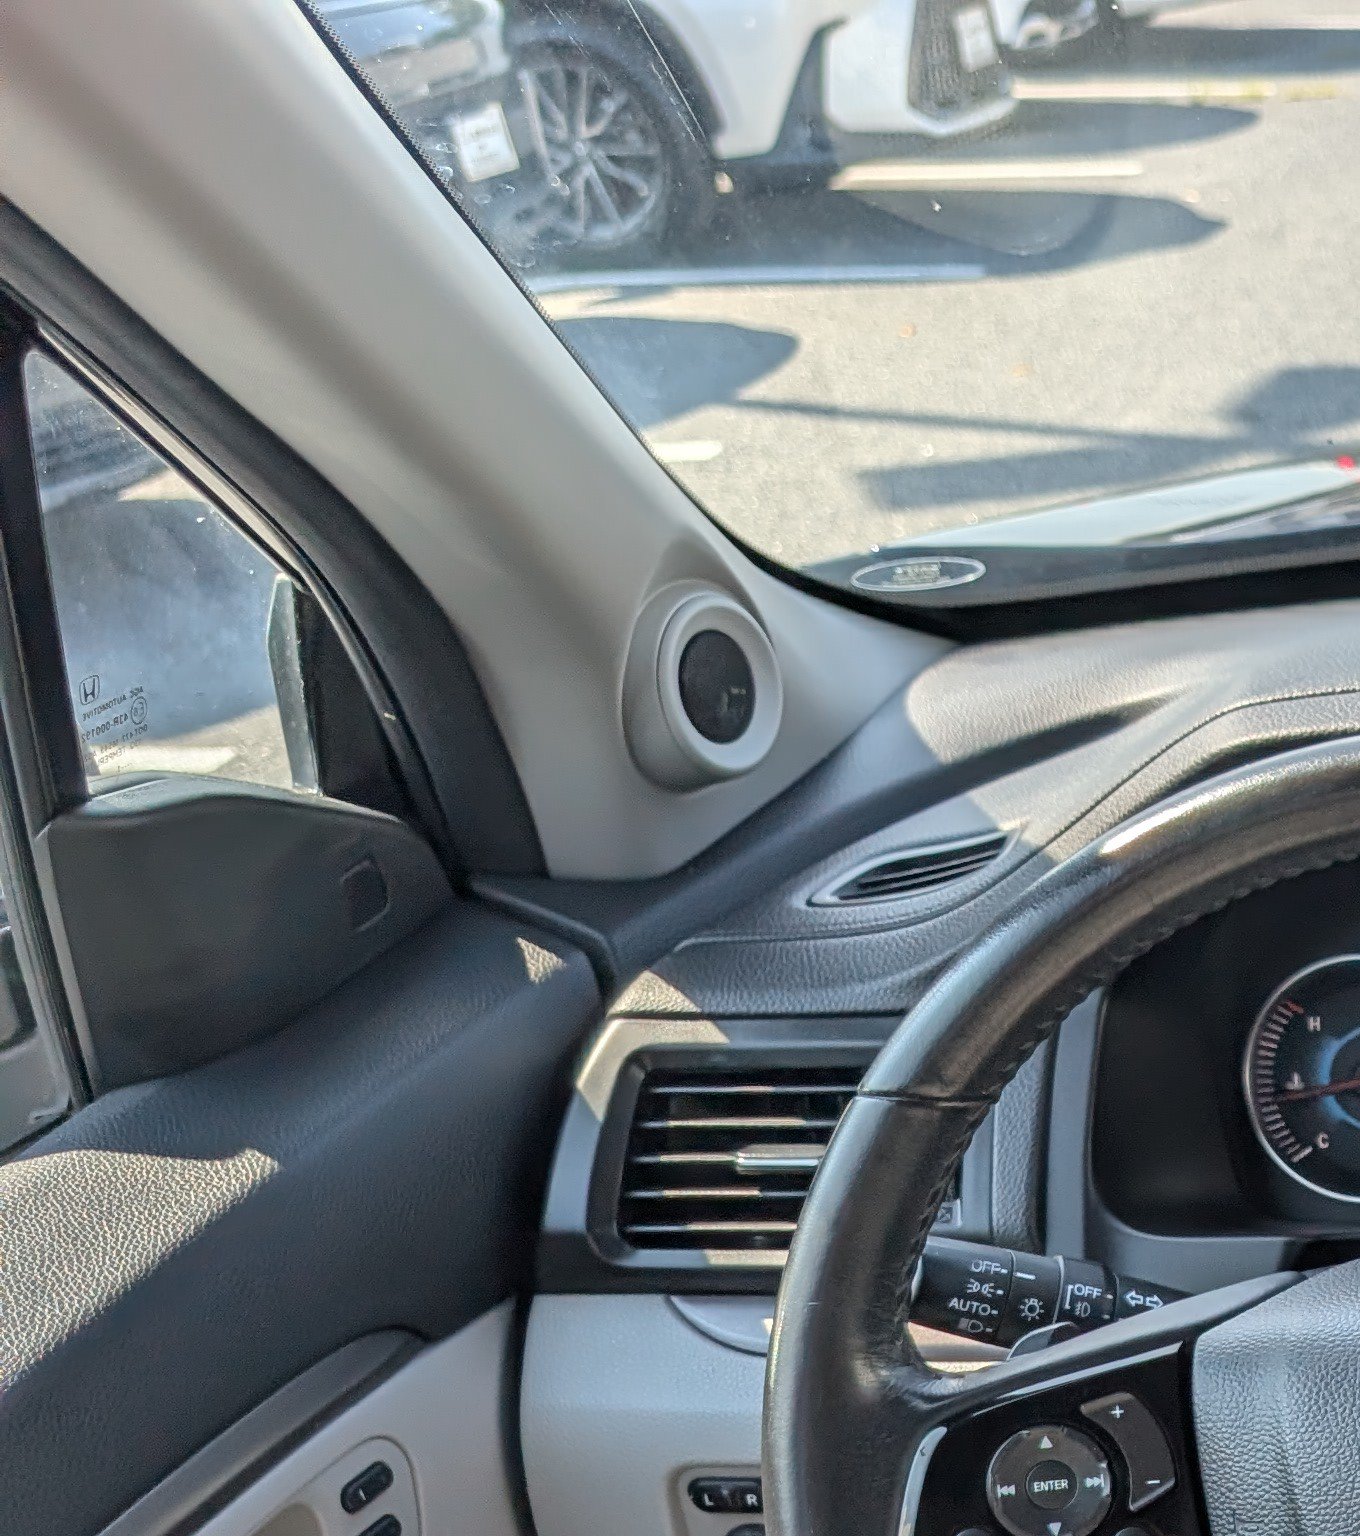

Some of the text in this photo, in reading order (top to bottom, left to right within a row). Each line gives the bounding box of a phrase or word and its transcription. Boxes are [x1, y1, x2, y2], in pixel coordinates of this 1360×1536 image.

[1308, 1016, 1322, 1032] H
[1317, 1131, 1330, 1149] C
[970, 1259, 1003, 1275] OFF
[1073, 1283, 1103, 1299] OFF
[949, 1297, 991, 1316] AUTO
[1033, 1477, 1069, 1493] ENTER
[703, 1493, 759, 1506] L R
